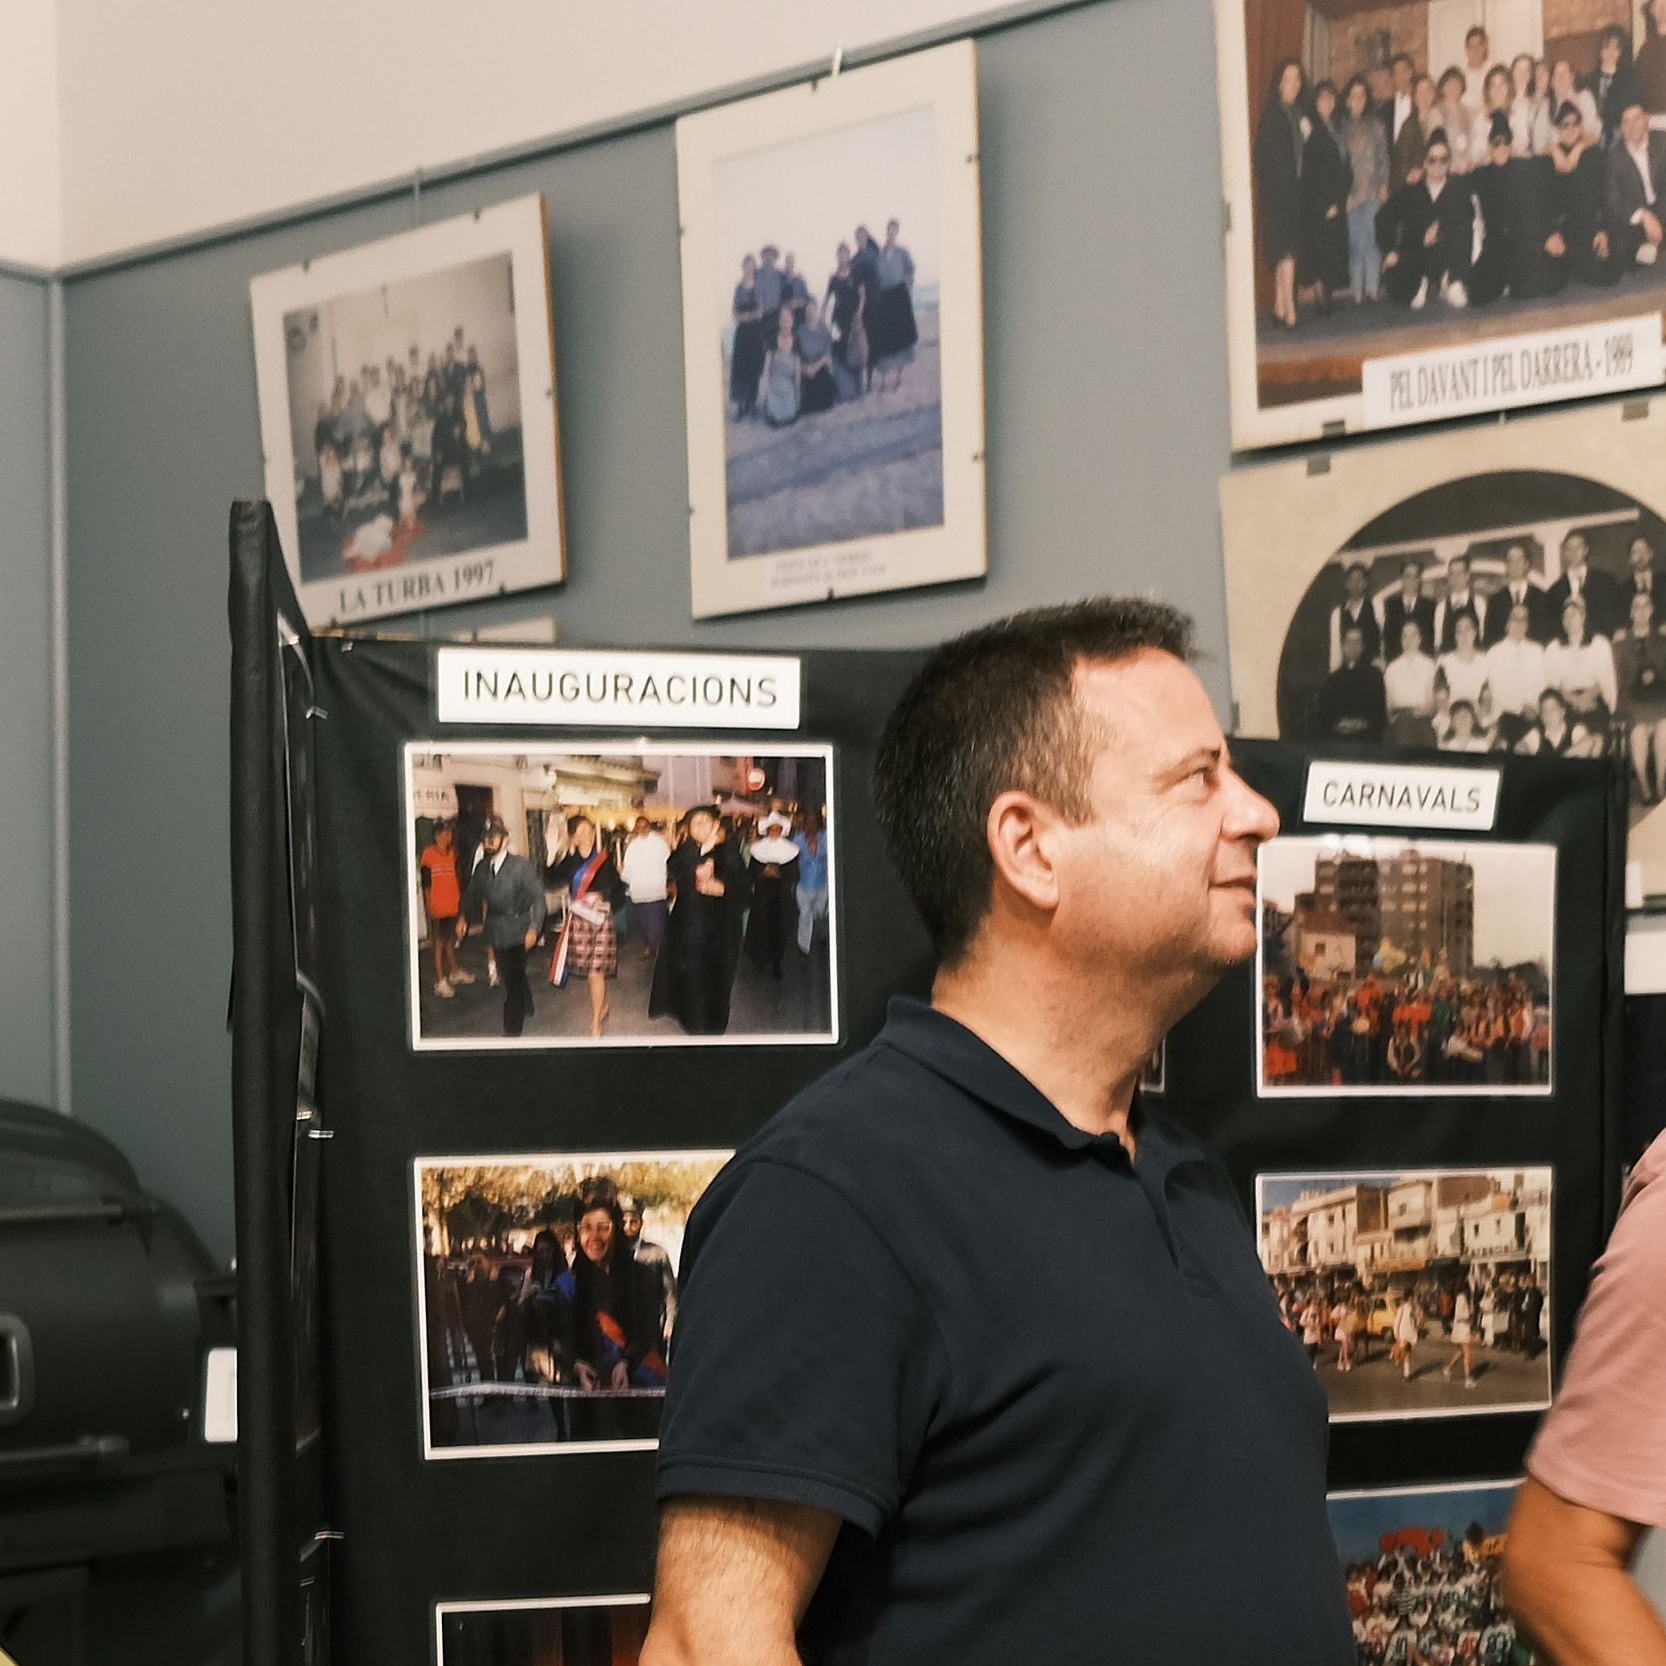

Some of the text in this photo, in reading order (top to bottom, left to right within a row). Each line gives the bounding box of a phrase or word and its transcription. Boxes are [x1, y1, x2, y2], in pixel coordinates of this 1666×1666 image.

[1390, 367, 1415, 412] PEL
[1418, 358, 1479, 406] DAVANT
[1491, 352, 1517, 396] PEL
[1520, 341, 1594, 392] DARRERA
[339, 558, 495, 614] LA TURBA 1997
[462, 670, 779, 708] INAUGURACIONS
[1322, 779, 1482, 814] CARNAVALS
